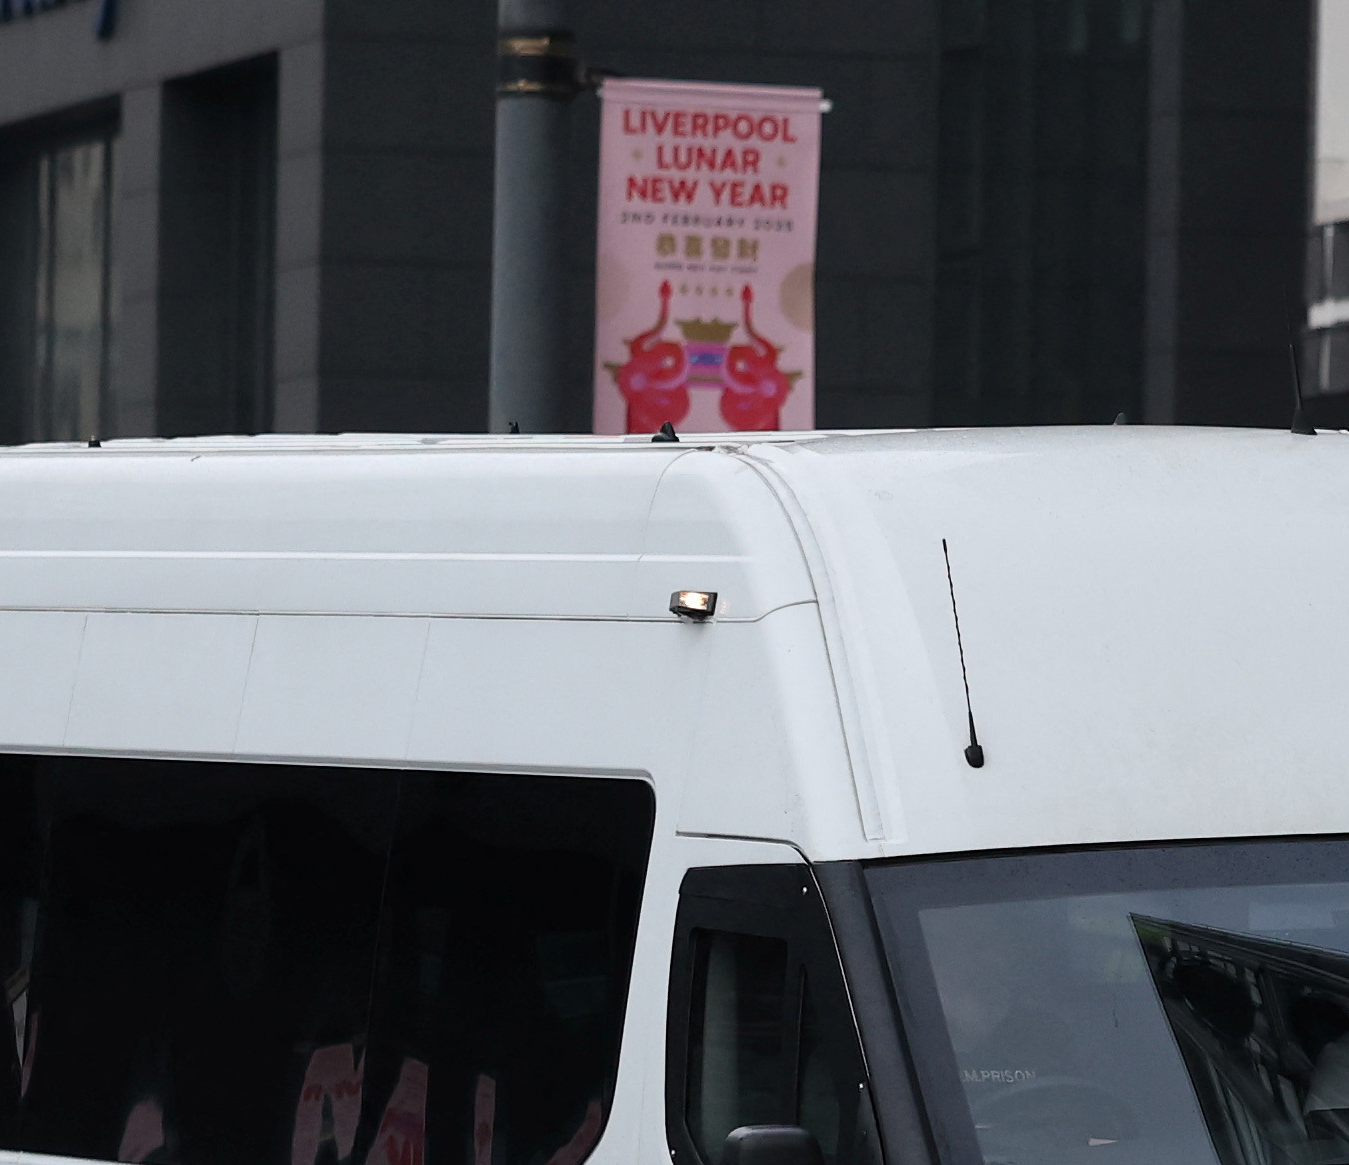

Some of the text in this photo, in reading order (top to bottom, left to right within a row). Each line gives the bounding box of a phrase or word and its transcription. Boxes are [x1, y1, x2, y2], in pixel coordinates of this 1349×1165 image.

[623, 108, 797, 144] LIVERPOOL
[656, 146, 760, 173] LUNAR
[626, 176, 789, 209] NEW YEAR
